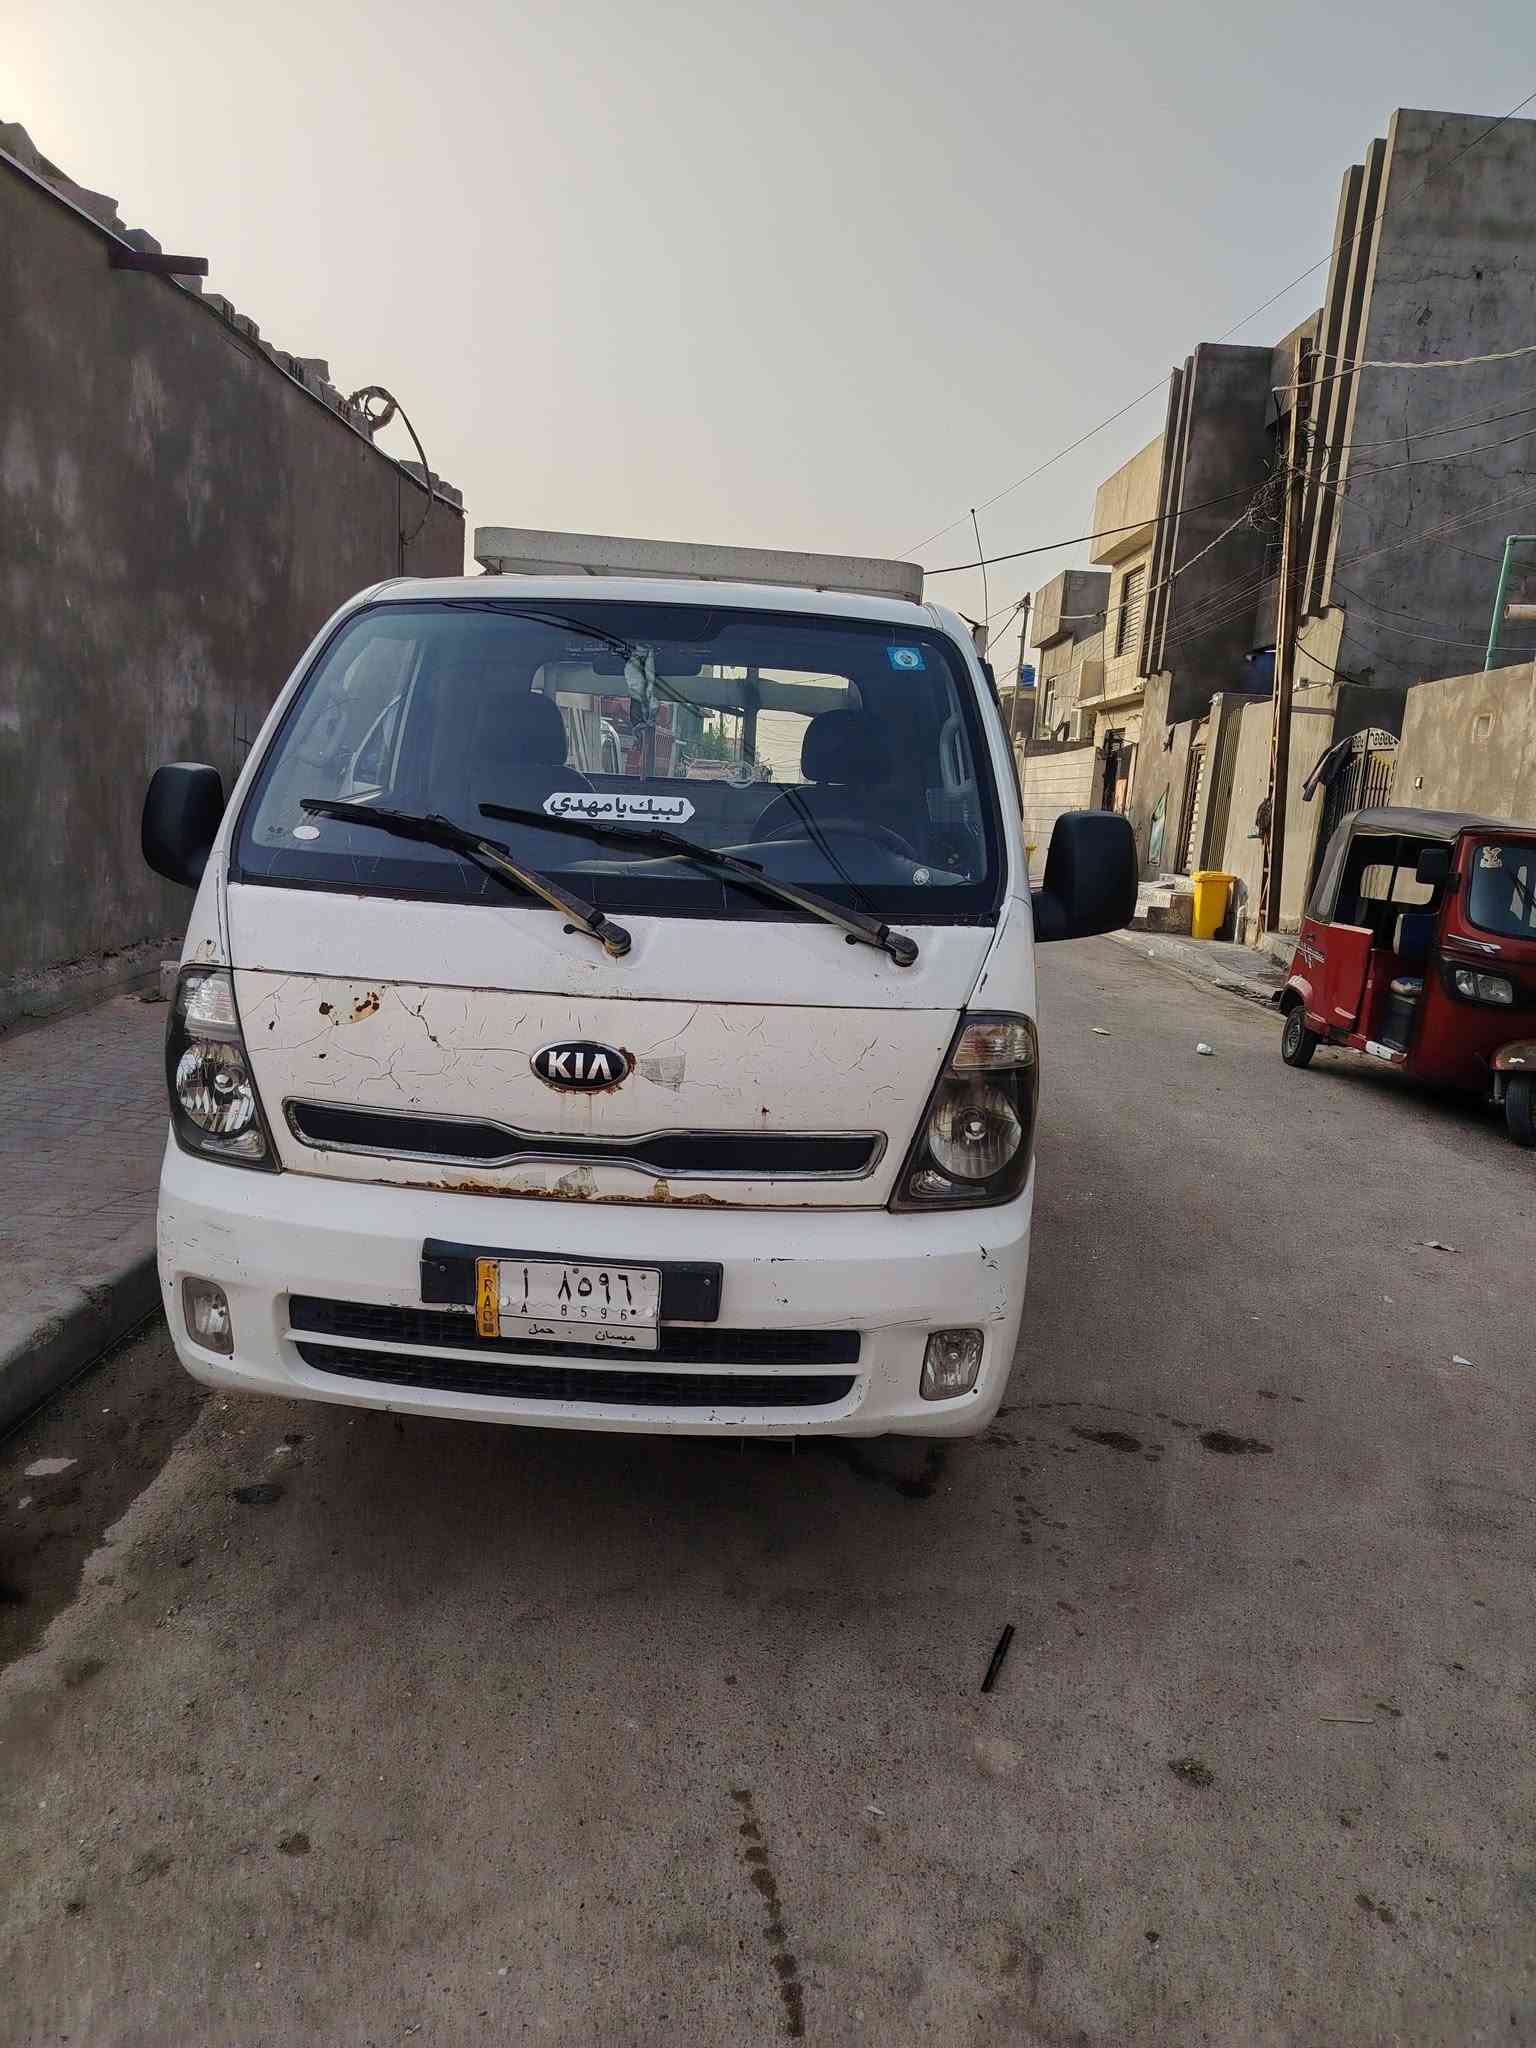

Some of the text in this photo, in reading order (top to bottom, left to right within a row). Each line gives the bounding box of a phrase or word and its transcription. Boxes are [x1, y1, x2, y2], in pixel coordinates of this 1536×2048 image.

[550, 796, 685, 820] لبيك يا مهدي
[547, 1051, 613, 1080] KIA
[557, 1270, 633, 1306] ٨٥٩٦
[520, 1302, 528, 1314] A
[528, 1323, 637, 1342] ميسان حمل
